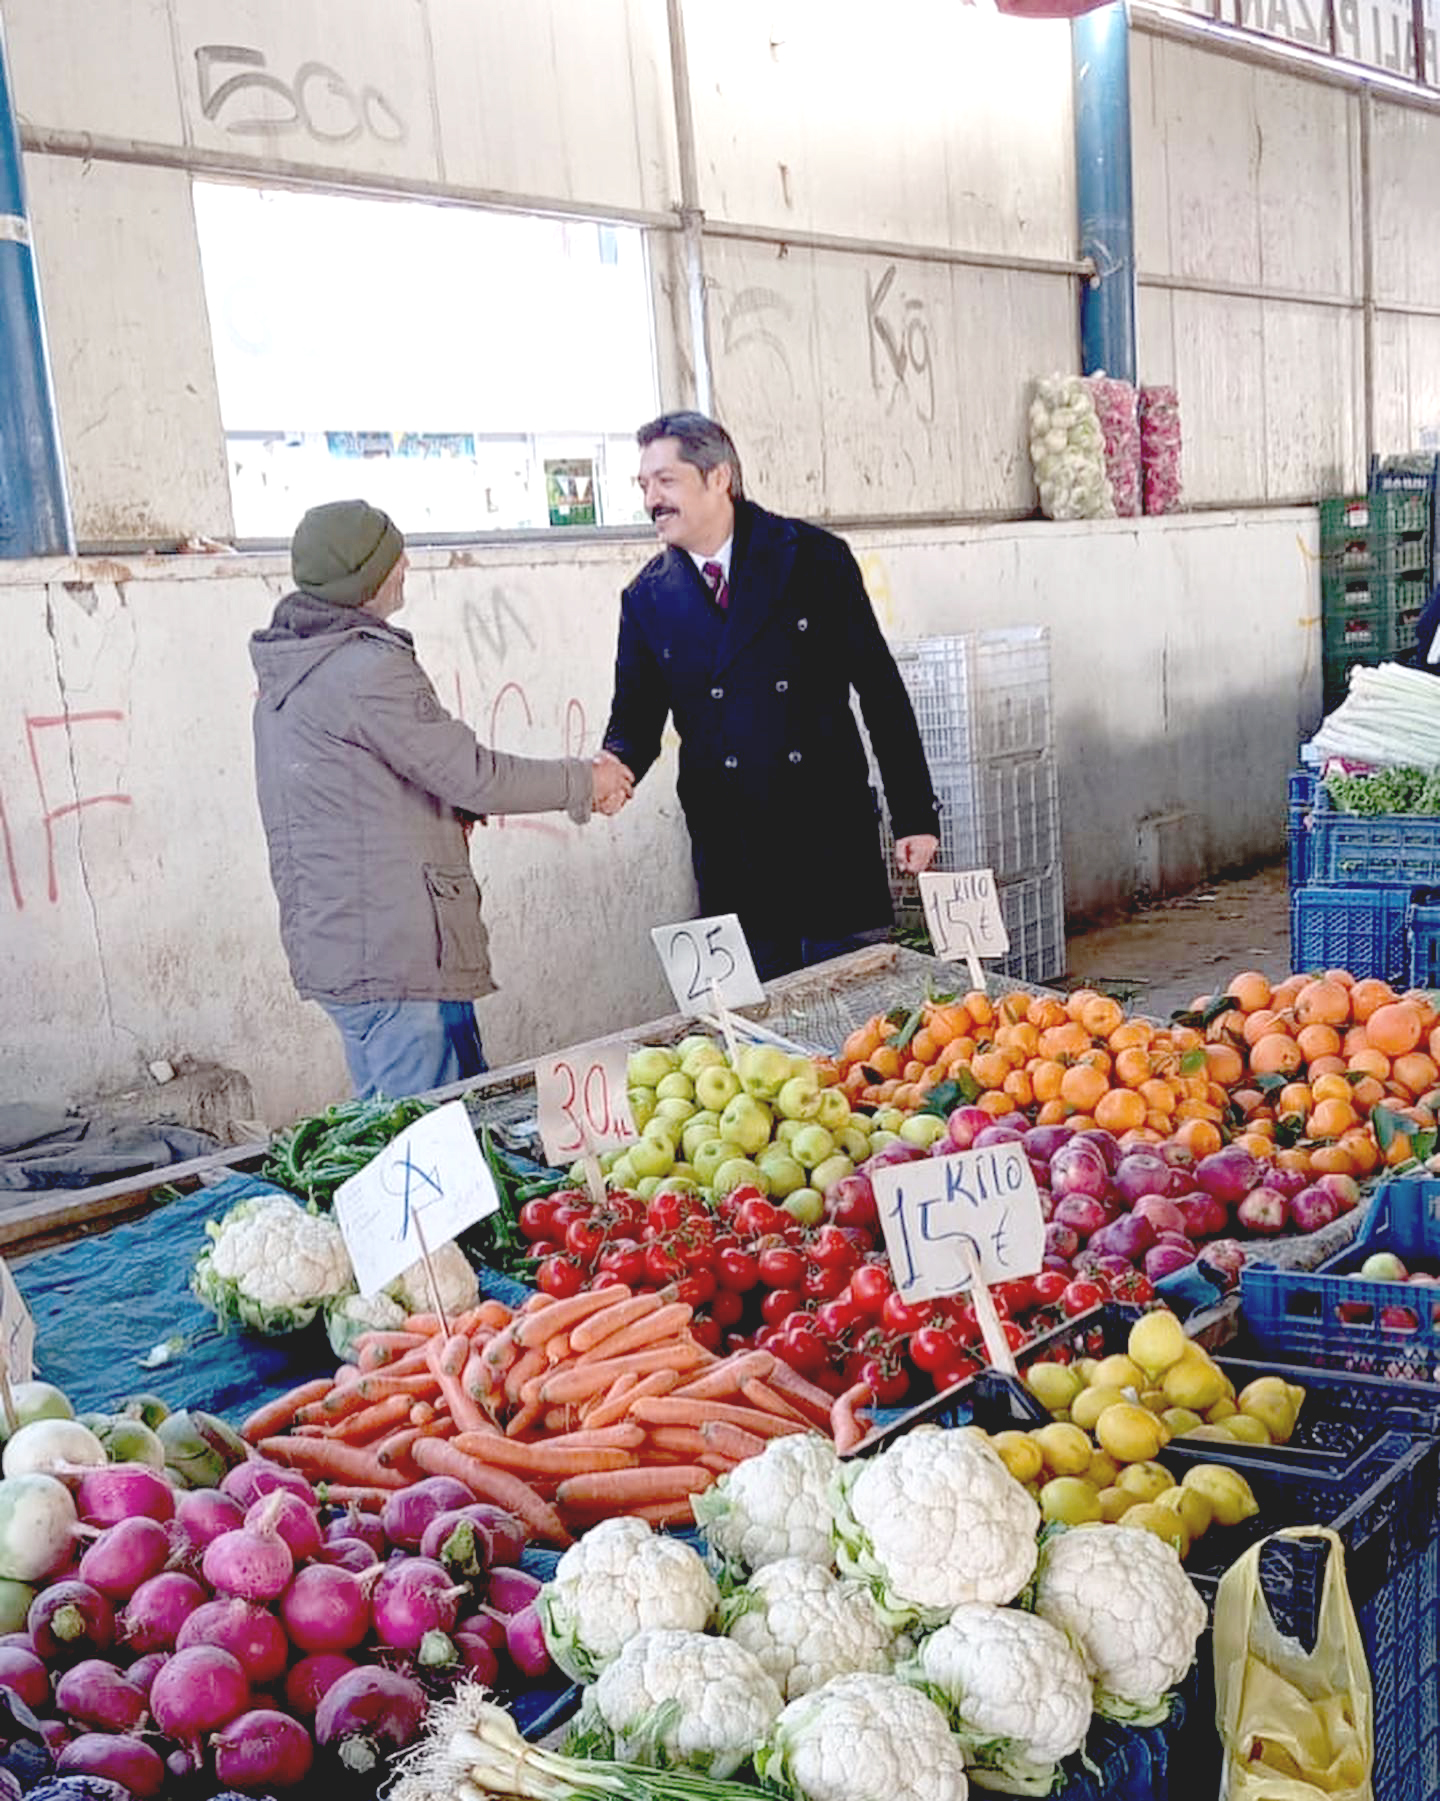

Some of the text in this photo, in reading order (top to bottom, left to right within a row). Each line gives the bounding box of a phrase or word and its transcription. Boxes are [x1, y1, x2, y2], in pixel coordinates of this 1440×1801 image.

[670, 925, 735, 1000] 25
[553, 1063, 609, 1151] 30
[889, 1187, 982, 1291] 15
